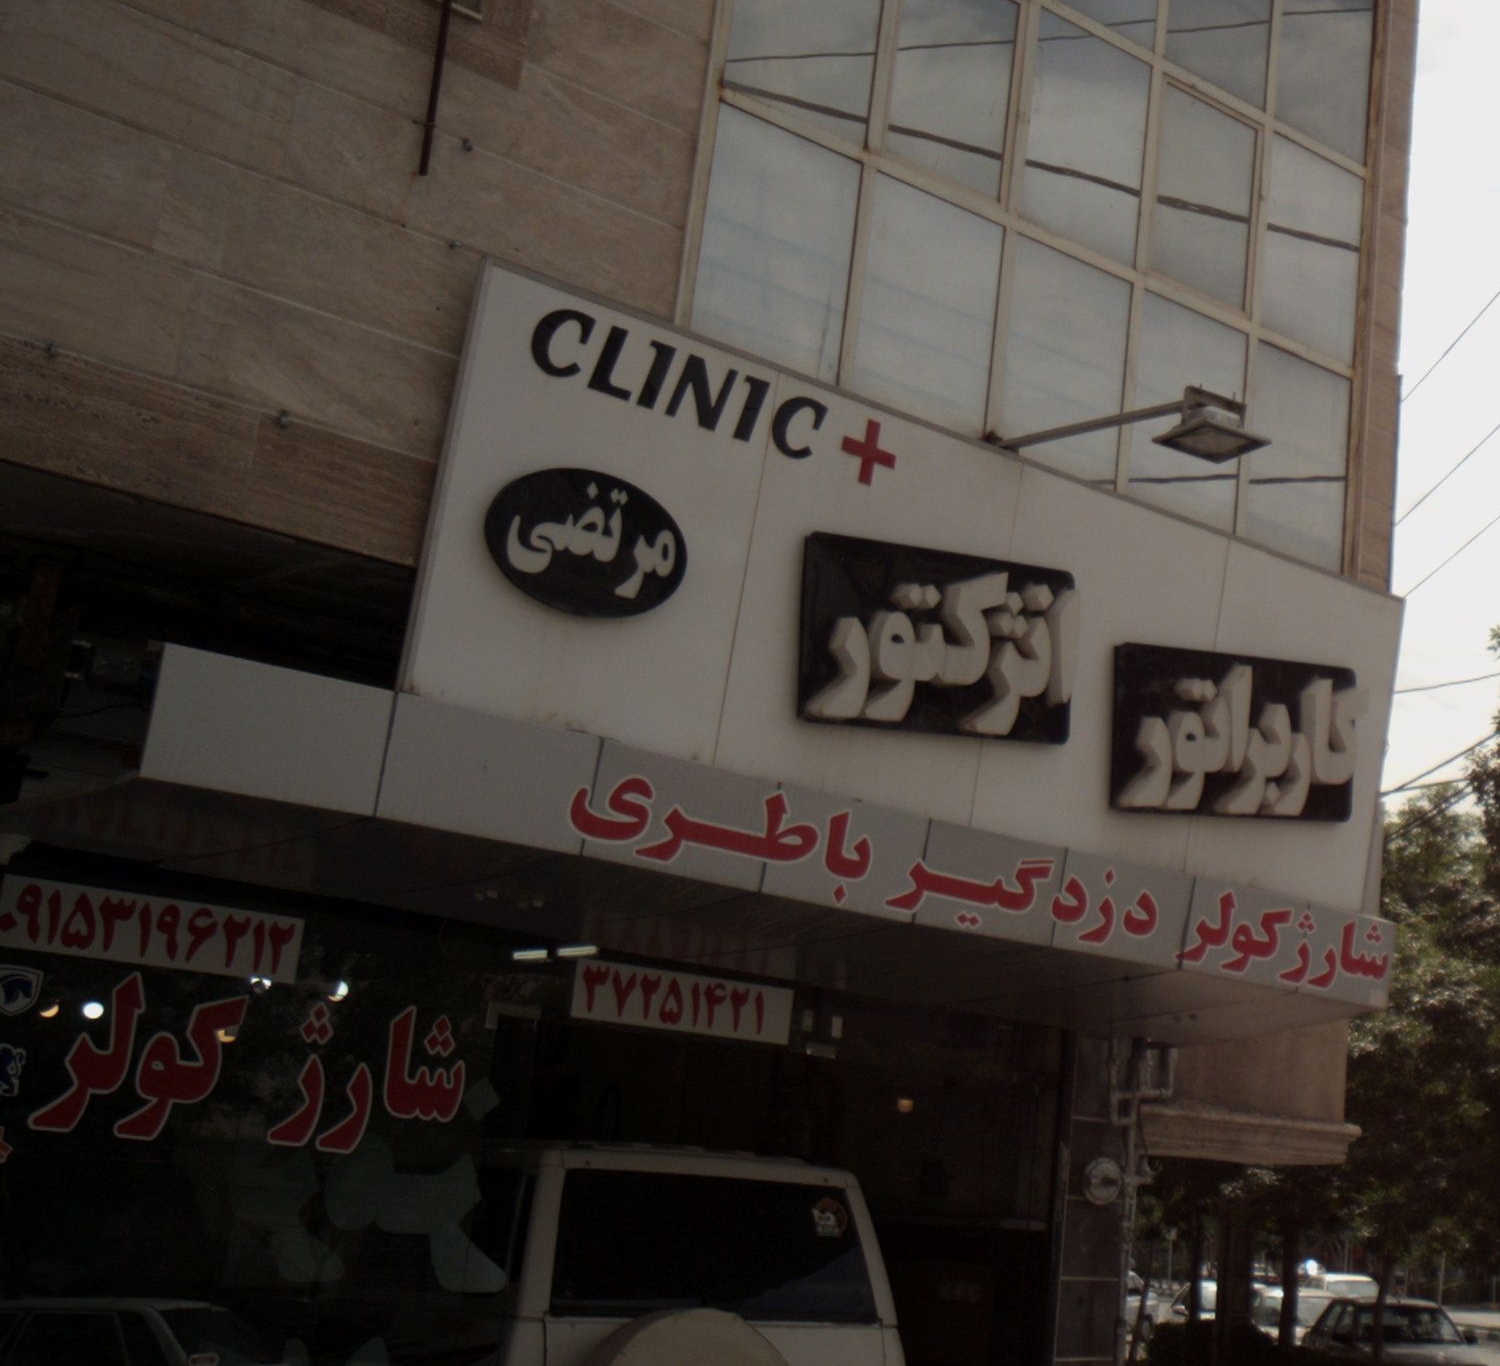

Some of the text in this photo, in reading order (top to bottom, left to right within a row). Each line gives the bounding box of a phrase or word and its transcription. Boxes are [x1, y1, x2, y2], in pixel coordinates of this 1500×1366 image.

[506, 480, 677, 600] مرتضی
[804, 571, 1080, 736] انژکتور
[1113, 662, 1370, 817] کاربراتور
[885, 858, 1158, 944] دزدگیر
[27, 971, 466, 1154] شارژ کولر
[582, 965, 765, 1035] ۳۷۲۵۱۴۲۱
